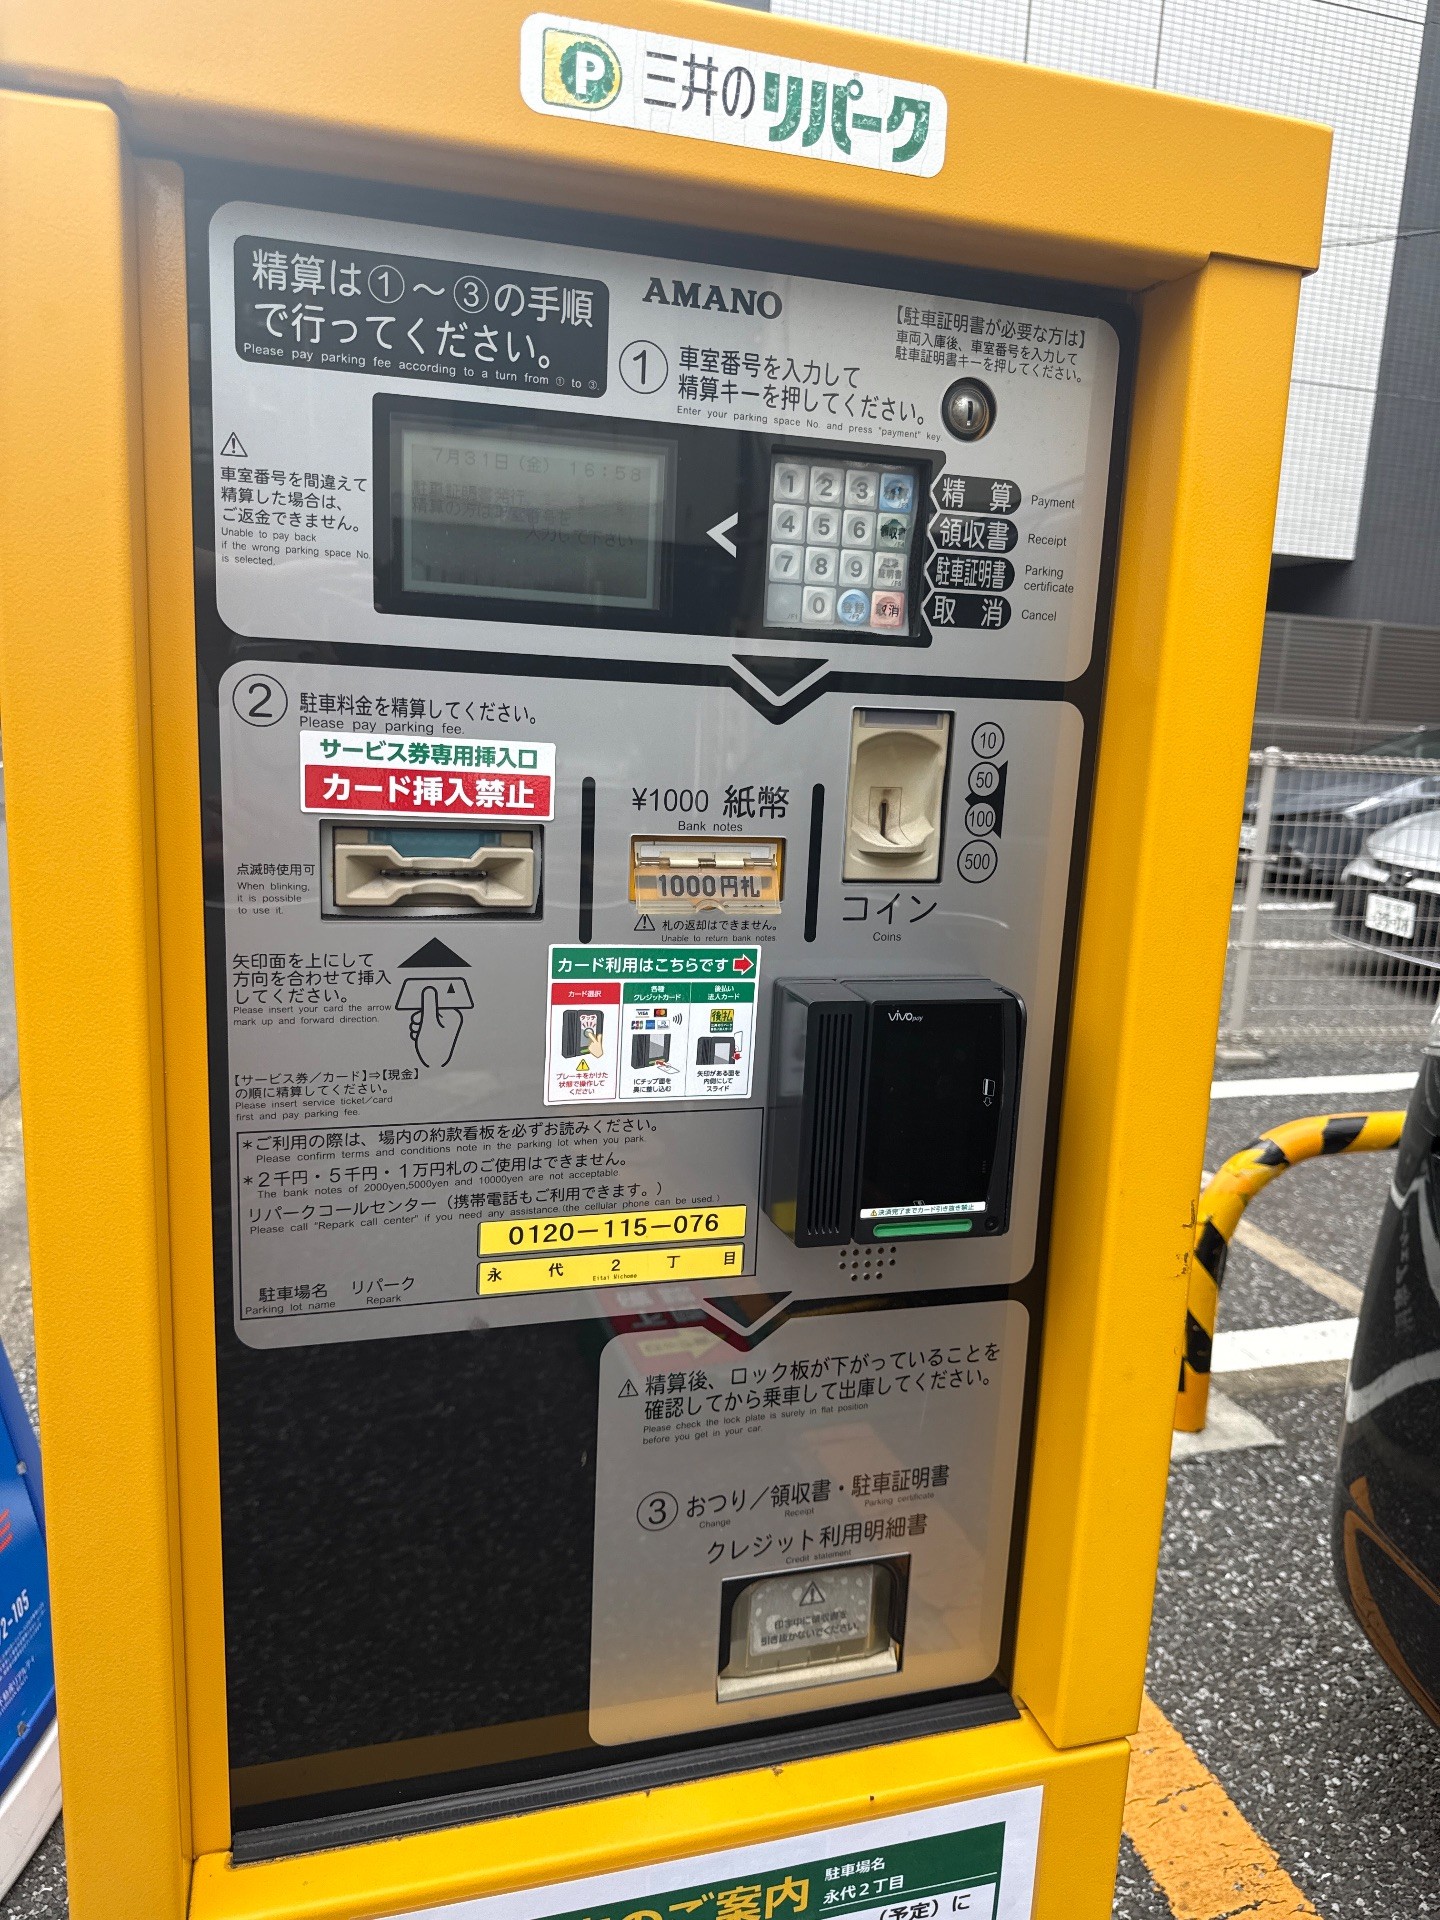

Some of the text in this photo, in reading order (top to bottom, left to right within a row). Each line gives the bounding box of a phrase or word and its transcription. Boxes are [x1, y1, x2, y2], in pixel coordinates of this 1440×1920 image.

[575, 51, 604, 94] P
[644, 50, 930, 162] 三井のリパーク
[643, 278, 782, 319] AMANO
[254, 303, 550, 368] で行ってください。
[896, 305, 1085, 349] 【駐車証明書が必要な方は】
[896, 330, 1077, 365] 車両入庫後、車室番号を入力して
[244, 343, 581, 388] Please pay parking fee according to a turn from to
[680, 345, 860, 388] 車室番号を入力して
[895, 346, 1082, 383] 駐車証明書キーを押してください。
[678, 374, 924, 425] 精算キーを押してください。
[677, 406, 872, 435] Enter your parking space and press
[221, 466, 367, 492] 車室番号を間違えて
[787, 476, 794, 493] 1
[820, 479, 832, 496] 2
[221, 486, 341, 510] 精算した場合は、
[856, 482, 868, 499] 3
[1032, 495, 1075, 508] Payment
[223, 506, 358, 532] ご返金できません。
[782, 516, 795, 532] 4
[818, 518, 830, 536] 5
[221, 527, 316, 542] Unable to pay back
[854, 521, 865, 538] 6
[940, 519, 1008, 550] 領収書
[1028, 534, 1066, 547] Receipt
[222, 541, 351, 558] if the wrong parking space
[781, 555, 793, 572] 7
[815, 558, 827, 575] 8
[851, 560, 862, 577] 9
[936, 556, 1006, 588] 駐車証明書
[1025, 565, 1063, 579] Parking
[1024, 581, 1074, 594] certificate
[812, 597, 824, 614] 0
[1021, 610, 1056, 621] Cancel
[300, 692, 536, 725] 駐車料金を精算してください。
[300, 716, 464, 735] Please pay parking fee.
[980, 732, 996, 750] 10
[320, 739, 537, 769] サービス券専用挿入口
[976, 772, 992, 788] 50
[323, 774, 534, 809] カード挿入禁止
[632, 785, 789, 819] ¥1000 紙幣
[678, 820, 742, 832] Bank notes
[969, 811, 993, 827] 100
[236, 863, 315, 876] 点滅時使用可
[965, 854, 990, 870] 500
[237, 882, 264, 890] When
[659, 875, 760, 898] 1000円札
[262, 895, 302, 903] possible
[843, 893, 937, 924] コイン
[662, 920, 777, 931] 札の返却はできません。
[873, 932, 901, 941] Coins
[232, 953, 373, 969] 矢印面を上にして
[558, 957, 728, 974] カード利用はこちらです
[233, 970, 391, 987] 方向を合わせて挿入
[236, 988, 347, 1004] してください。
[651, 985, 665, 993] 各種
[299, 1006, 318, 1014] your
[349, 1004, 362, 1012] the
[234, 1018, 256, 1026] mark
[556, 1072, 608, 1080] ブレーキをかけた
[236, 1084, 388, 1099] の順に精算してください。
[298, 1146, 450, 1161] confirm terms conditions
[480, 1176, 523, 1185] 10000yen
[622, 1200, 649, 1209] phone
[259, 1276, 415, 1302] 駐車場名 リパーク
[367, 1295, 401, 1305] Repark
[246, 1302, 335, 1316] Parking name
[645, 1342, 1000, 1397] 精算後、ロック板が下がっていることを
[644, 1368, 992, 1421] 確認してから乗車して出庫してください。
[643, 1403, 868, 1434] Please surely position
[643, 1428, 743, 1445] before you your
[700, 1492, 934, 1529] Change Receipt Parking certificate
[707, 1513, 927, 1564] クレジット利用明細書
[786, 1549, 851, 1565] Credit statement
[0, 1588, 30, 1646] 2-105
[825, 1856, 885, 1881] 駐車場名
[824, 1874, 904, 1904] 永代2丁目
[582, 1876, 810, 1920] ご案内
